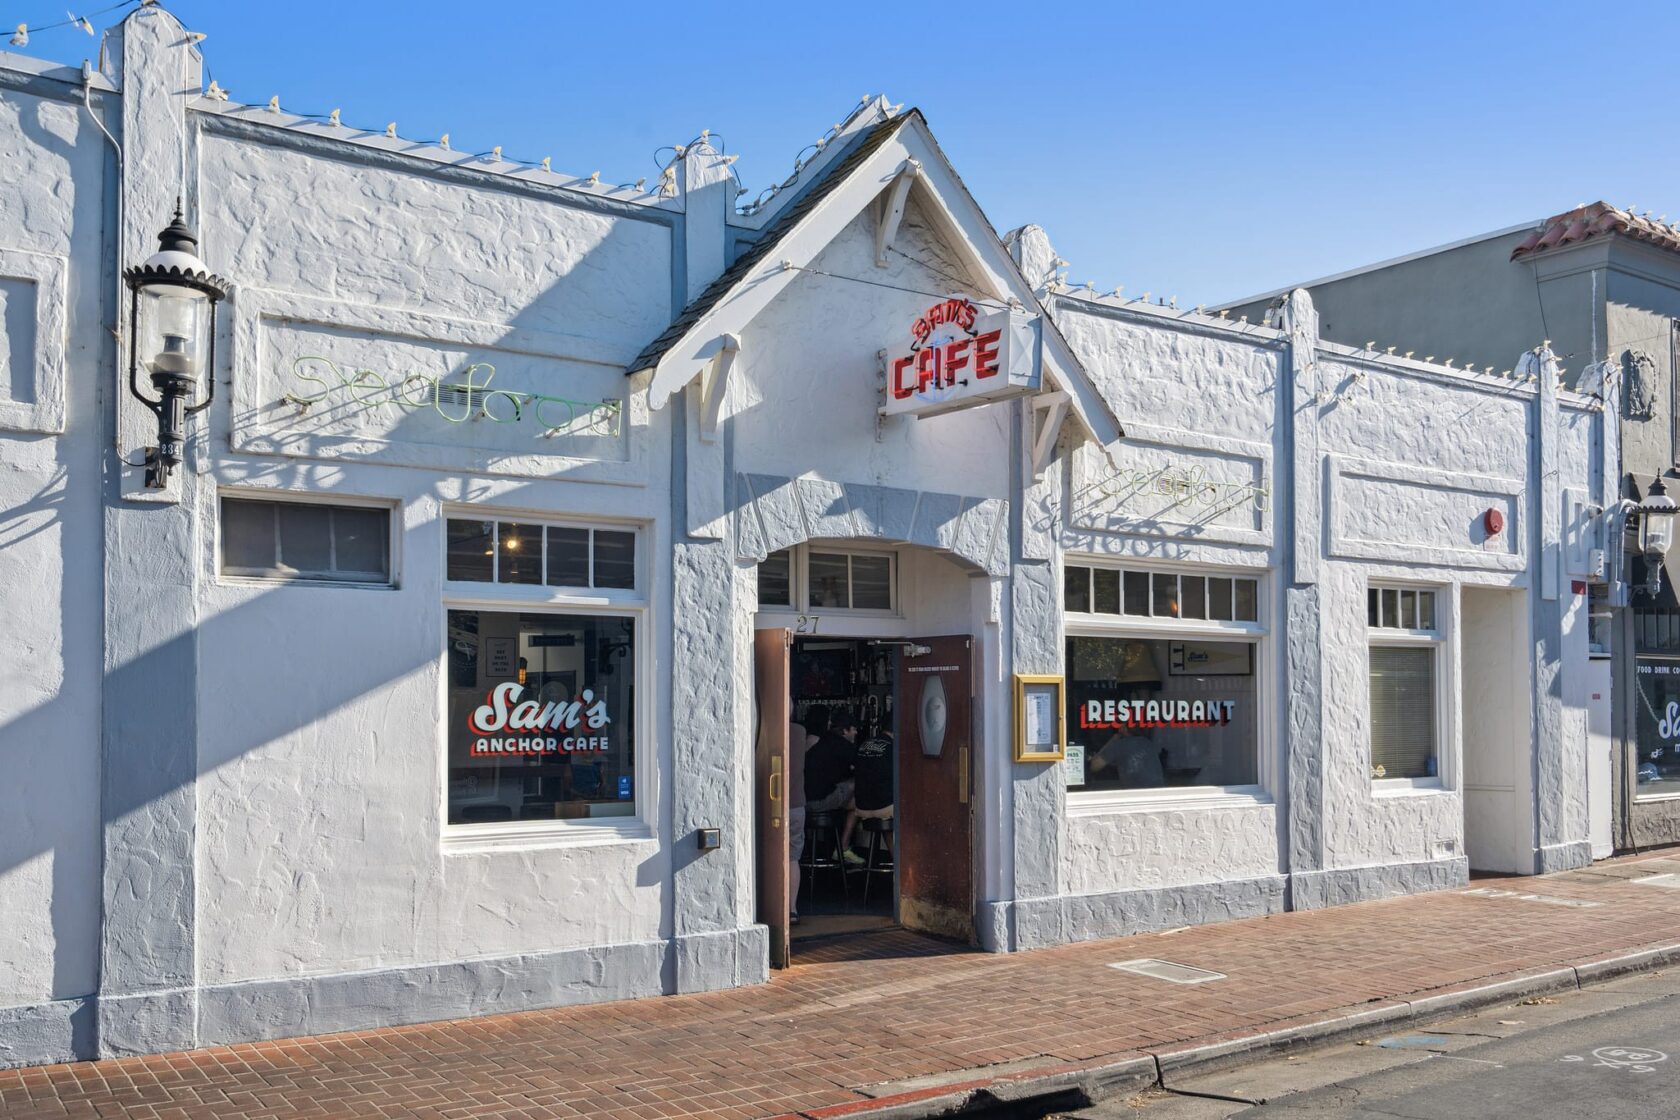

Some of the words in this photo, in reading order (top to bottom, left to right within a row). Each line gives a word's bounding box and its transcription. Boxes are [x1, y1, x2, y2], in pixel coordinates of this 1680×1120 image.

[889, 328, 1002, 401] CAFE
[796, 614, 820, 634] 27
[1637, 665, 1652, 674] FOOD
[471, 681, 611, 733] Sam's
[1085, 699, 1236, 724] RESTAURANT
[474, 737, 558, 753] ANCHOR
[562, 736, 609, 752] CAFE
